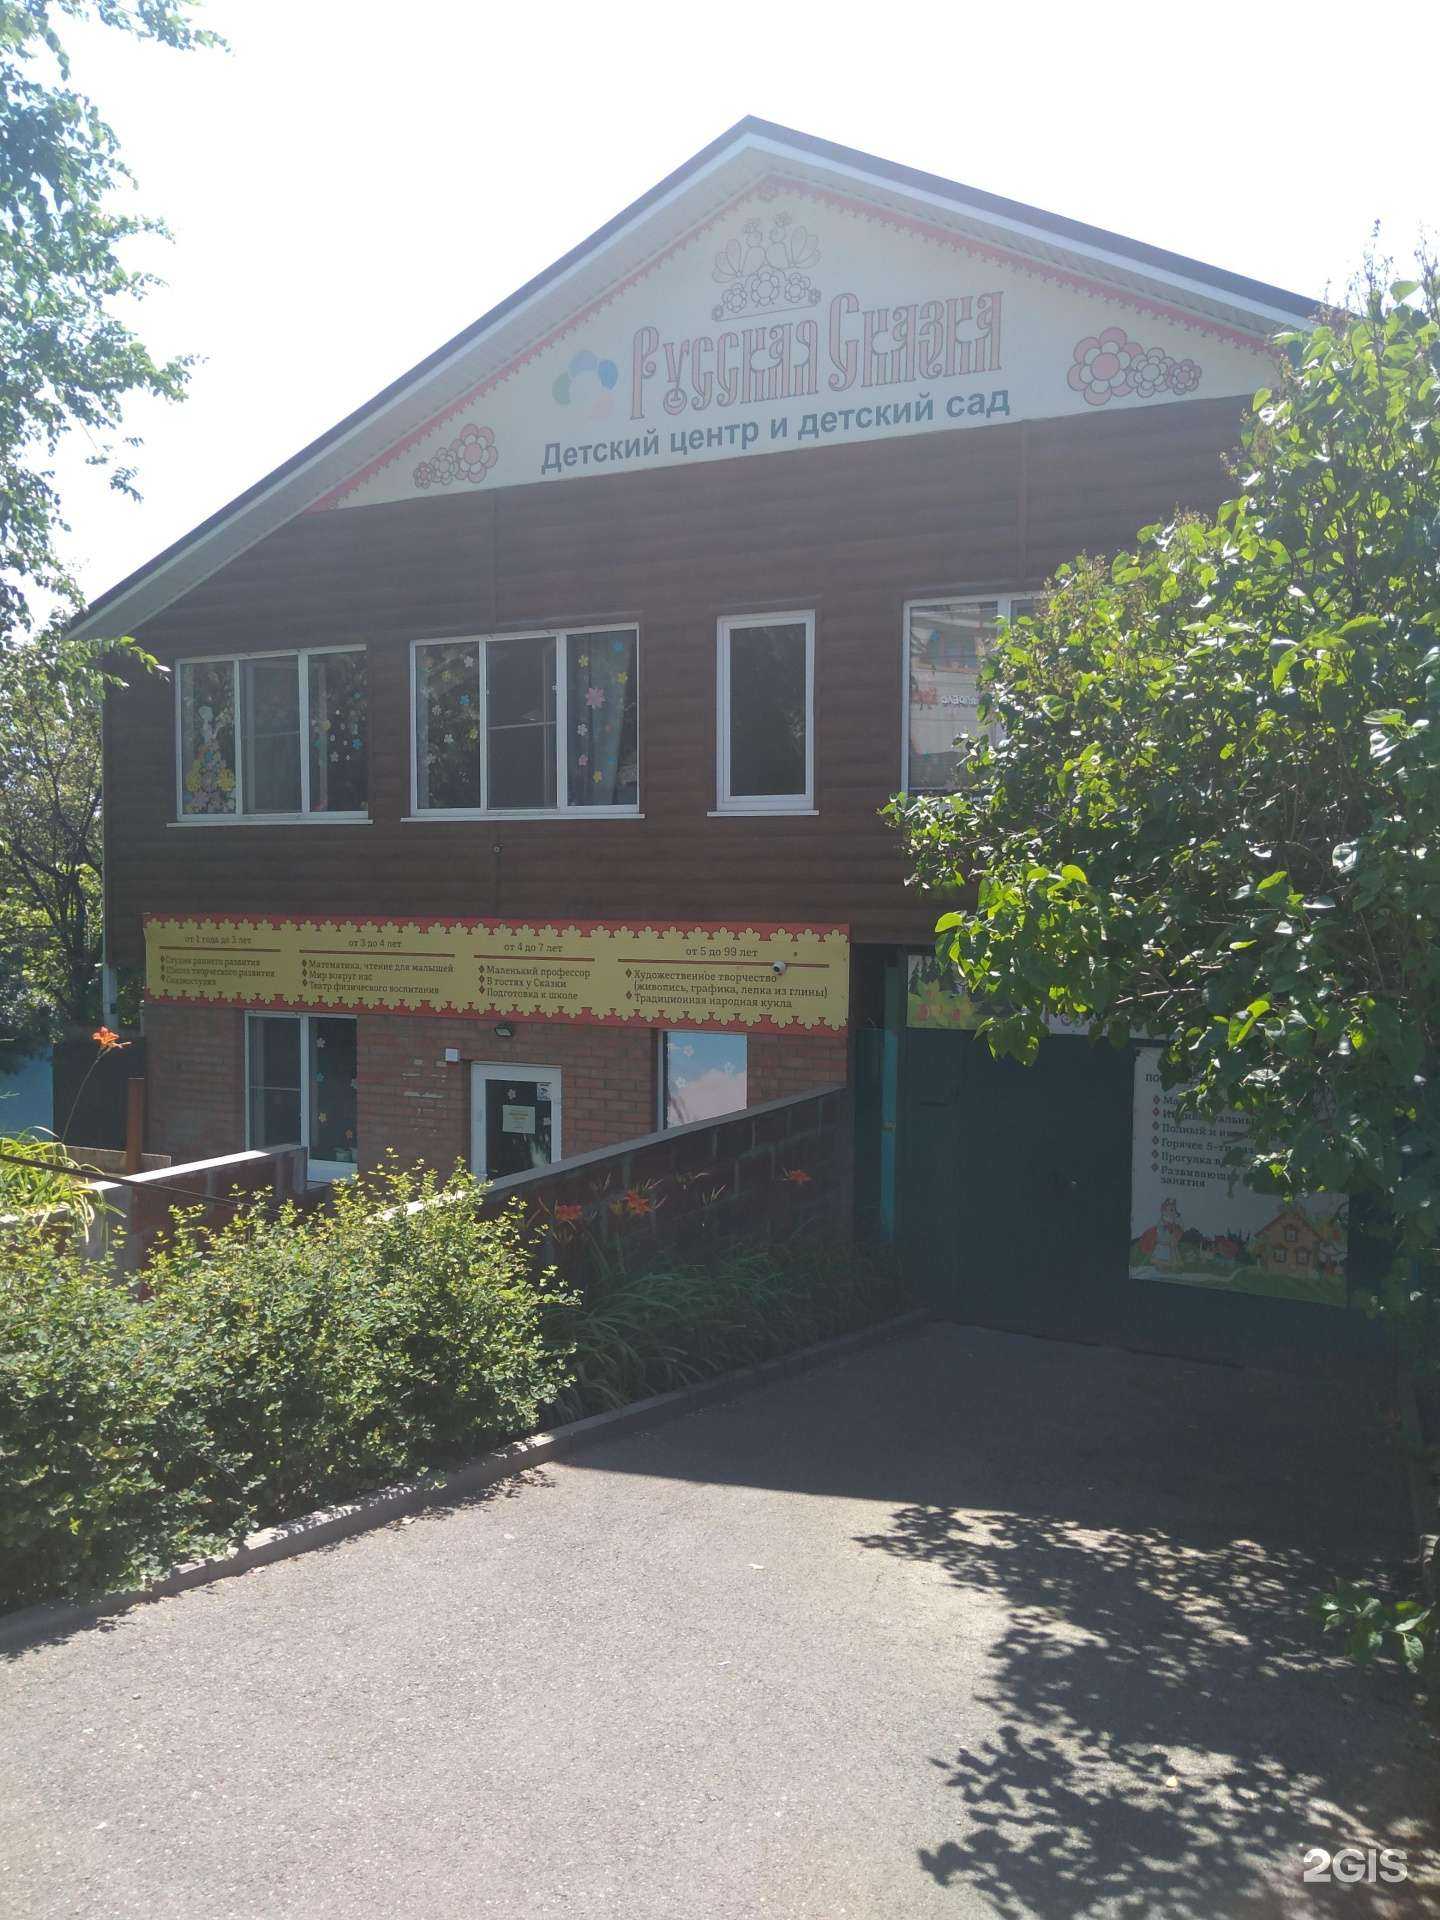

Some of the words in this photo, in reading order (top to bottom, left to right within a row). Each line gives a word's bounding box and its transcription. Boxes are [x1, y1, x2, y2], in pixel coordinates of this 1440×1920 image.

[629, 320, 819, 420] Русская
[828, 290, 1004, 392] Сказка
[541, 428, 660, 475] Детский
[670, 421, 759, 456] центр
[769, 416, 788, 440] и
[797, 391, 934, 440] детский
[945, 389, 1010, 419] сад
[348, 939, 358, 947] от
[360, 938, 366, 947] 3
[367, 940, 378, 948] до
[379, 939, 385, 947] 4
[386, 940, 401, 948] лет
[503, 944, 514, 952] от
[517, 943, 523, 951] 4
[525, 945, 536, 953] до
[538, 943, 544, 952] 7
[546, 944, 562, 953] лет
[686, 947, 698, 956] от
[700, 946, 707, 956] 5
[708, 948, 721, 958] до
[724, 947, 738, 957] 99
[740, 948, 758, 958] лет
[309, 960, 362, 971] Математика,
[365, 962, 392, 971] чтение
[394, 964, 410, 973] для
[412, 963, 455, 973] малышей
[486, 965, 538, 975] Маленький
[541, 968, 591, 980] профессор
[309, 971, 324, 981] Мир
[327, 972, 356, 982] вокруг
[357, 973, 373, 981] нас
[634, 969, 716, 982] Художественное
[718, 973, 777, 984] творчество
[310, 981, 332, 992] Театр
[333, 982, 388, 993] физического
[389, 984, 440, 994] воспитания
[495, 979, 524, 987] гостях
[533, 979, 567, 988] Сказки
[634, 980, 688, 992] (живопись,
[691, 984, 738, 995] графика,
[741, 985, 772, 995] лепка
[774, 987, 787, 996] из
[789, 985, 828, 999] глины)
[487, 988, 538, 999] Подготовка
[549, 992, 579, 1000] школе
[635, 993, 705, 1005] Традиционная
[708, 996, 758, 1008] народная
[760, 998, 792, 1009] кукла
